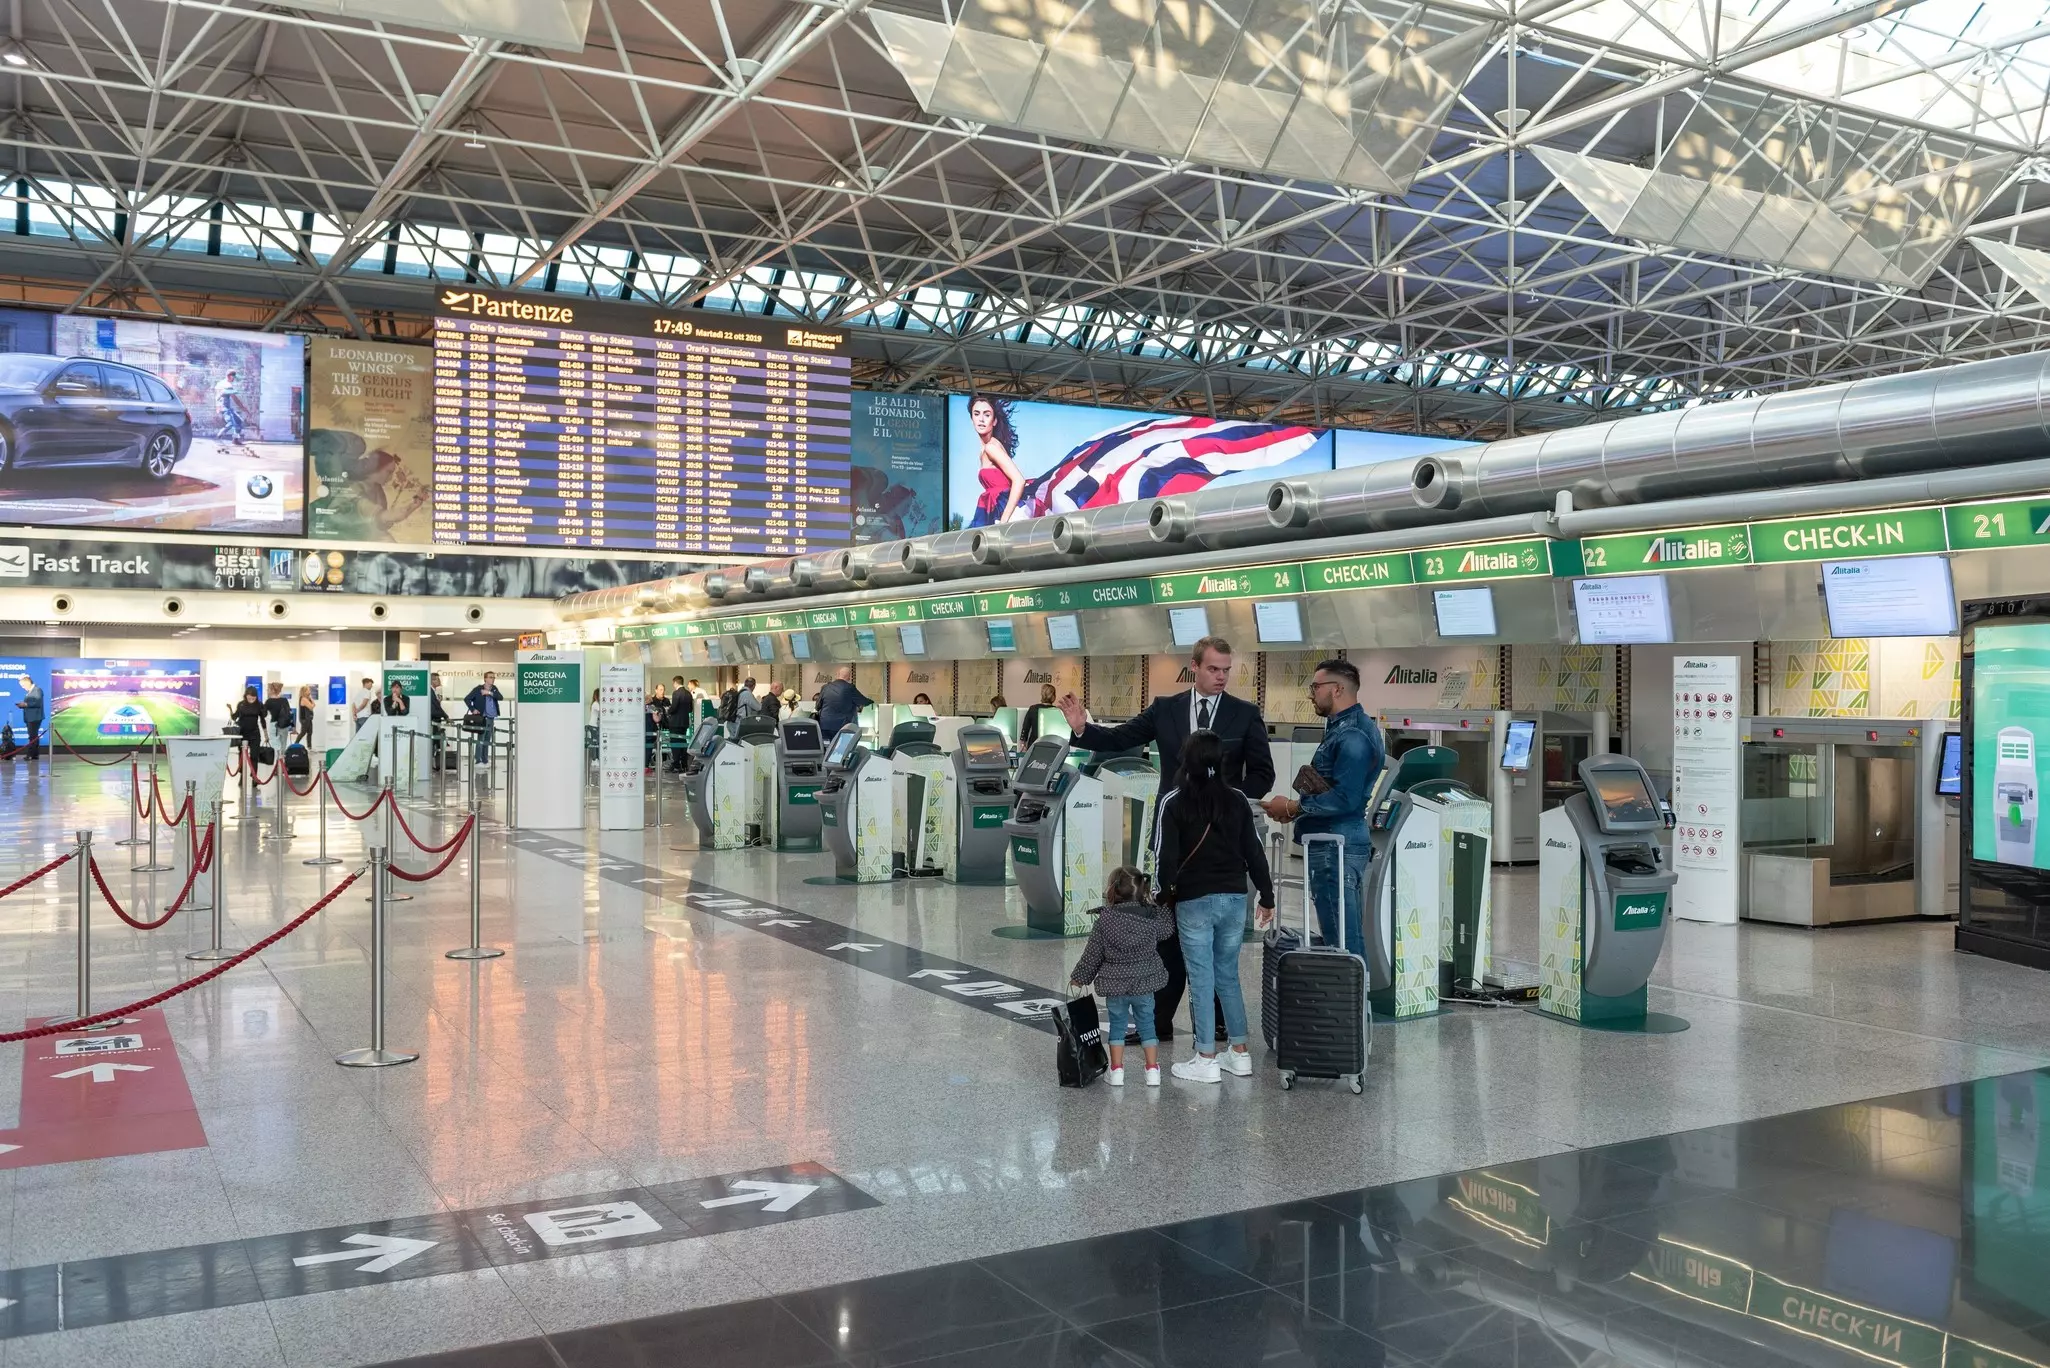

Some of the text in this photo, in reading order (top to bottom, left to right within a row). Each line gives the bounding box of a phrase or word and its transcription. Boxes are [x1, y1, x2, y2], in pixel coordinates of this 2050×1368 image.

[473, 294, 573, 323] Partenze
[437, 320, 633, 346] Volo Orario Destinazione Banco Gate Status
[654, 319, 692, 335] 17:49
[496, 337, 534, 346] Amsterdam
[804, 332, 842, 342] Aeroporti
[496, 346, 528, 355] Barcelona
[813, 341, 834, 349] Roma
[656, 341, 674, 350] Volo
[686, 344, 709, 353] Orario
[711, 347, 755, 357] Destinazione
[767, 352, 787, 360] Banco
[811, 356, 831, 364] Status
[496, 356, 522, 364] Bologna
[348, 361, 396, 375] WINGS.
[496, 365, 523, 373] Palermo
[332, 373, 412, 388] THE GENIUS
[496, 374, 526, 382] Frankfurt
[332, 385, 413, 401] AND FLIGHT
[875, 396, 920, 408] LE ALI DI
[868, 406, 926, 420] LEONARDO.
[876, 418, 920, 429] IL GENIO
[710, 428, 745, 437] Luxembourg
[873, 428, 921, 439] E IL VOLO
[1973, 513, 2006, 538] 21
[1783, 521, 1904, 552] CHECK-IN
[243, 548, 255, 556] FCO
[1584, 546, 1607, 567] 22
[1643, 537, 1722, 563] Alitalia
[33, 552, 150, 575] Fast Track
[215, 554, 261, 568] BEST
[271, 552, 292, 575] ACI
[1425, 557, 1445, 576] 23
[1457, 550, 1518, 573] Alitalia
[216, 568, 260, 576] AIRPORT
[1323, 562, 1389, 584] CHECK-IN
[1831, 566, 1860, 575] Alitalia
[1197, 575, 1237, 594] Alitalia
[1274, 572, 1290, 588] 24
[1093, 585, 1138, 602] CHECK-IN
[1160, 583, 1174, 597] 25
[1006, 594, 1035, 609] Alitalia
[1059, 591, 1070, 604] 26
[869, 606, 891, 620] Alitalia
[908, 605, 916, 616] 28
[931, 600, 965, 615] CHECK-IN
[980, 601, 988, 612] 27
[766, 616, 782, 628] Alitalia
[813, 612, 837, 624] CHECK-IN
[849, 611, 857, 621] 29
[723, 622, 743, 631] CHECK-IN
[1684, 660, 1708, 668] Alitalia
[906, 670, 929, 683] Alitalia
[1023, 669, 1053, 684] Alitalia
[1384, 665, 1437, 684] Alitalia
[1027, 760, 1047, 770] Alitalia
[1018, 844, 1032, 854] Alitalia
[1404, 841, 1426, 850] Alitalia
[1546, 838, 1566, 848] Alitalia
[1623, 906, 1648, 915] Alitalia
[486, 1213, 533, 1254] Self check-in
